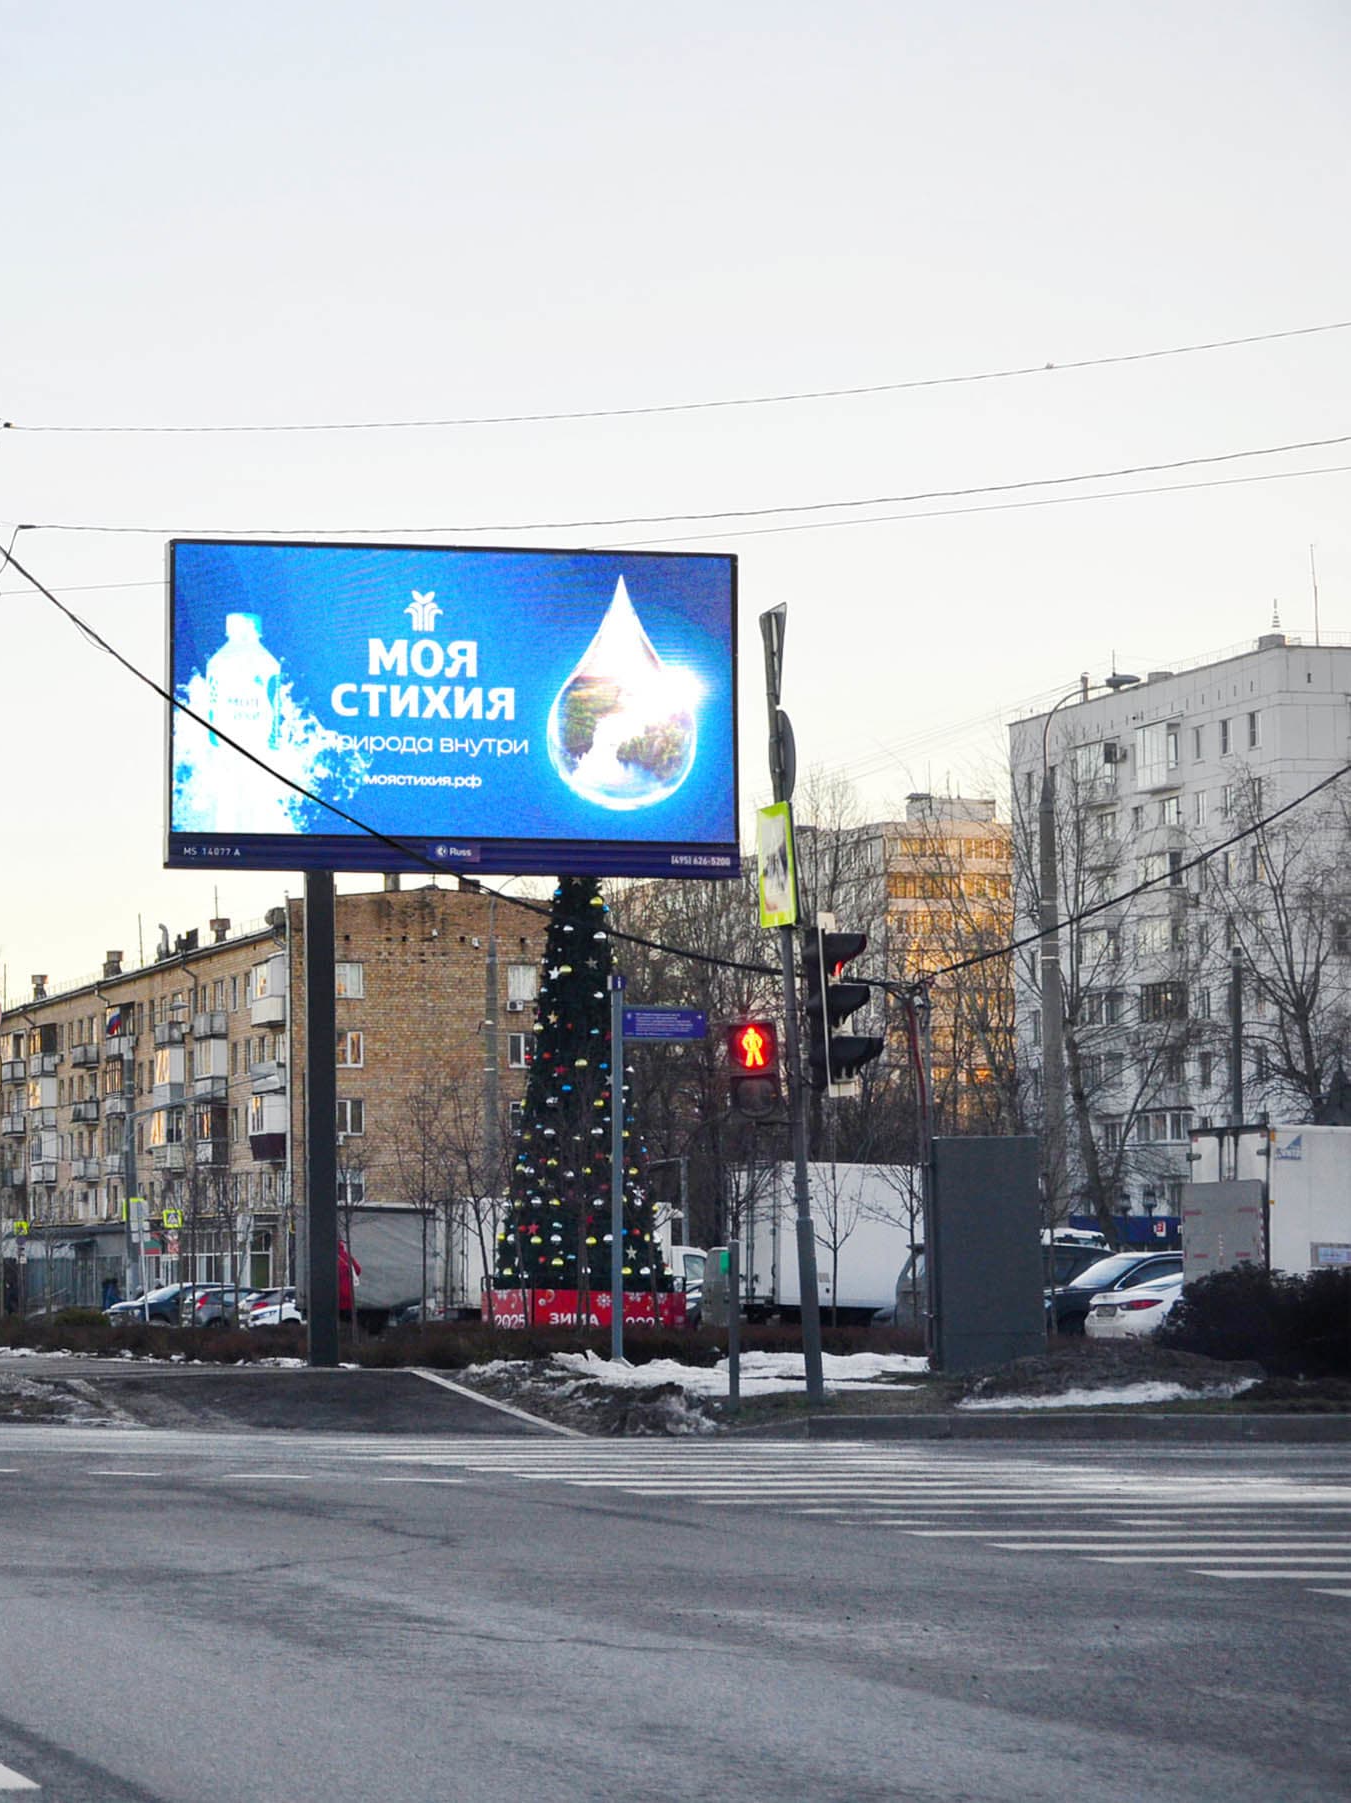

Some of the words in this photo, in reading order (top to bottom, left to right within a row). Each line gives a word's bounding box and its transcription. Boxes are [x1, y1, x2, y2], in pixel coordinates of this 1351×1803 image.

[367, 638, 478, 678] МОЯ
[330, 683, 516, 720] СТИХИЯ
[322, 734, 434, 755] рирода
[439, 737, 530, 757] внутри
[364, 774, 483, 789] моястихия.рф
[201, 847, 231, 856] 14077
[449, 847, 472, 857] Russ
[494, 1314, 525, 1329] 2025
